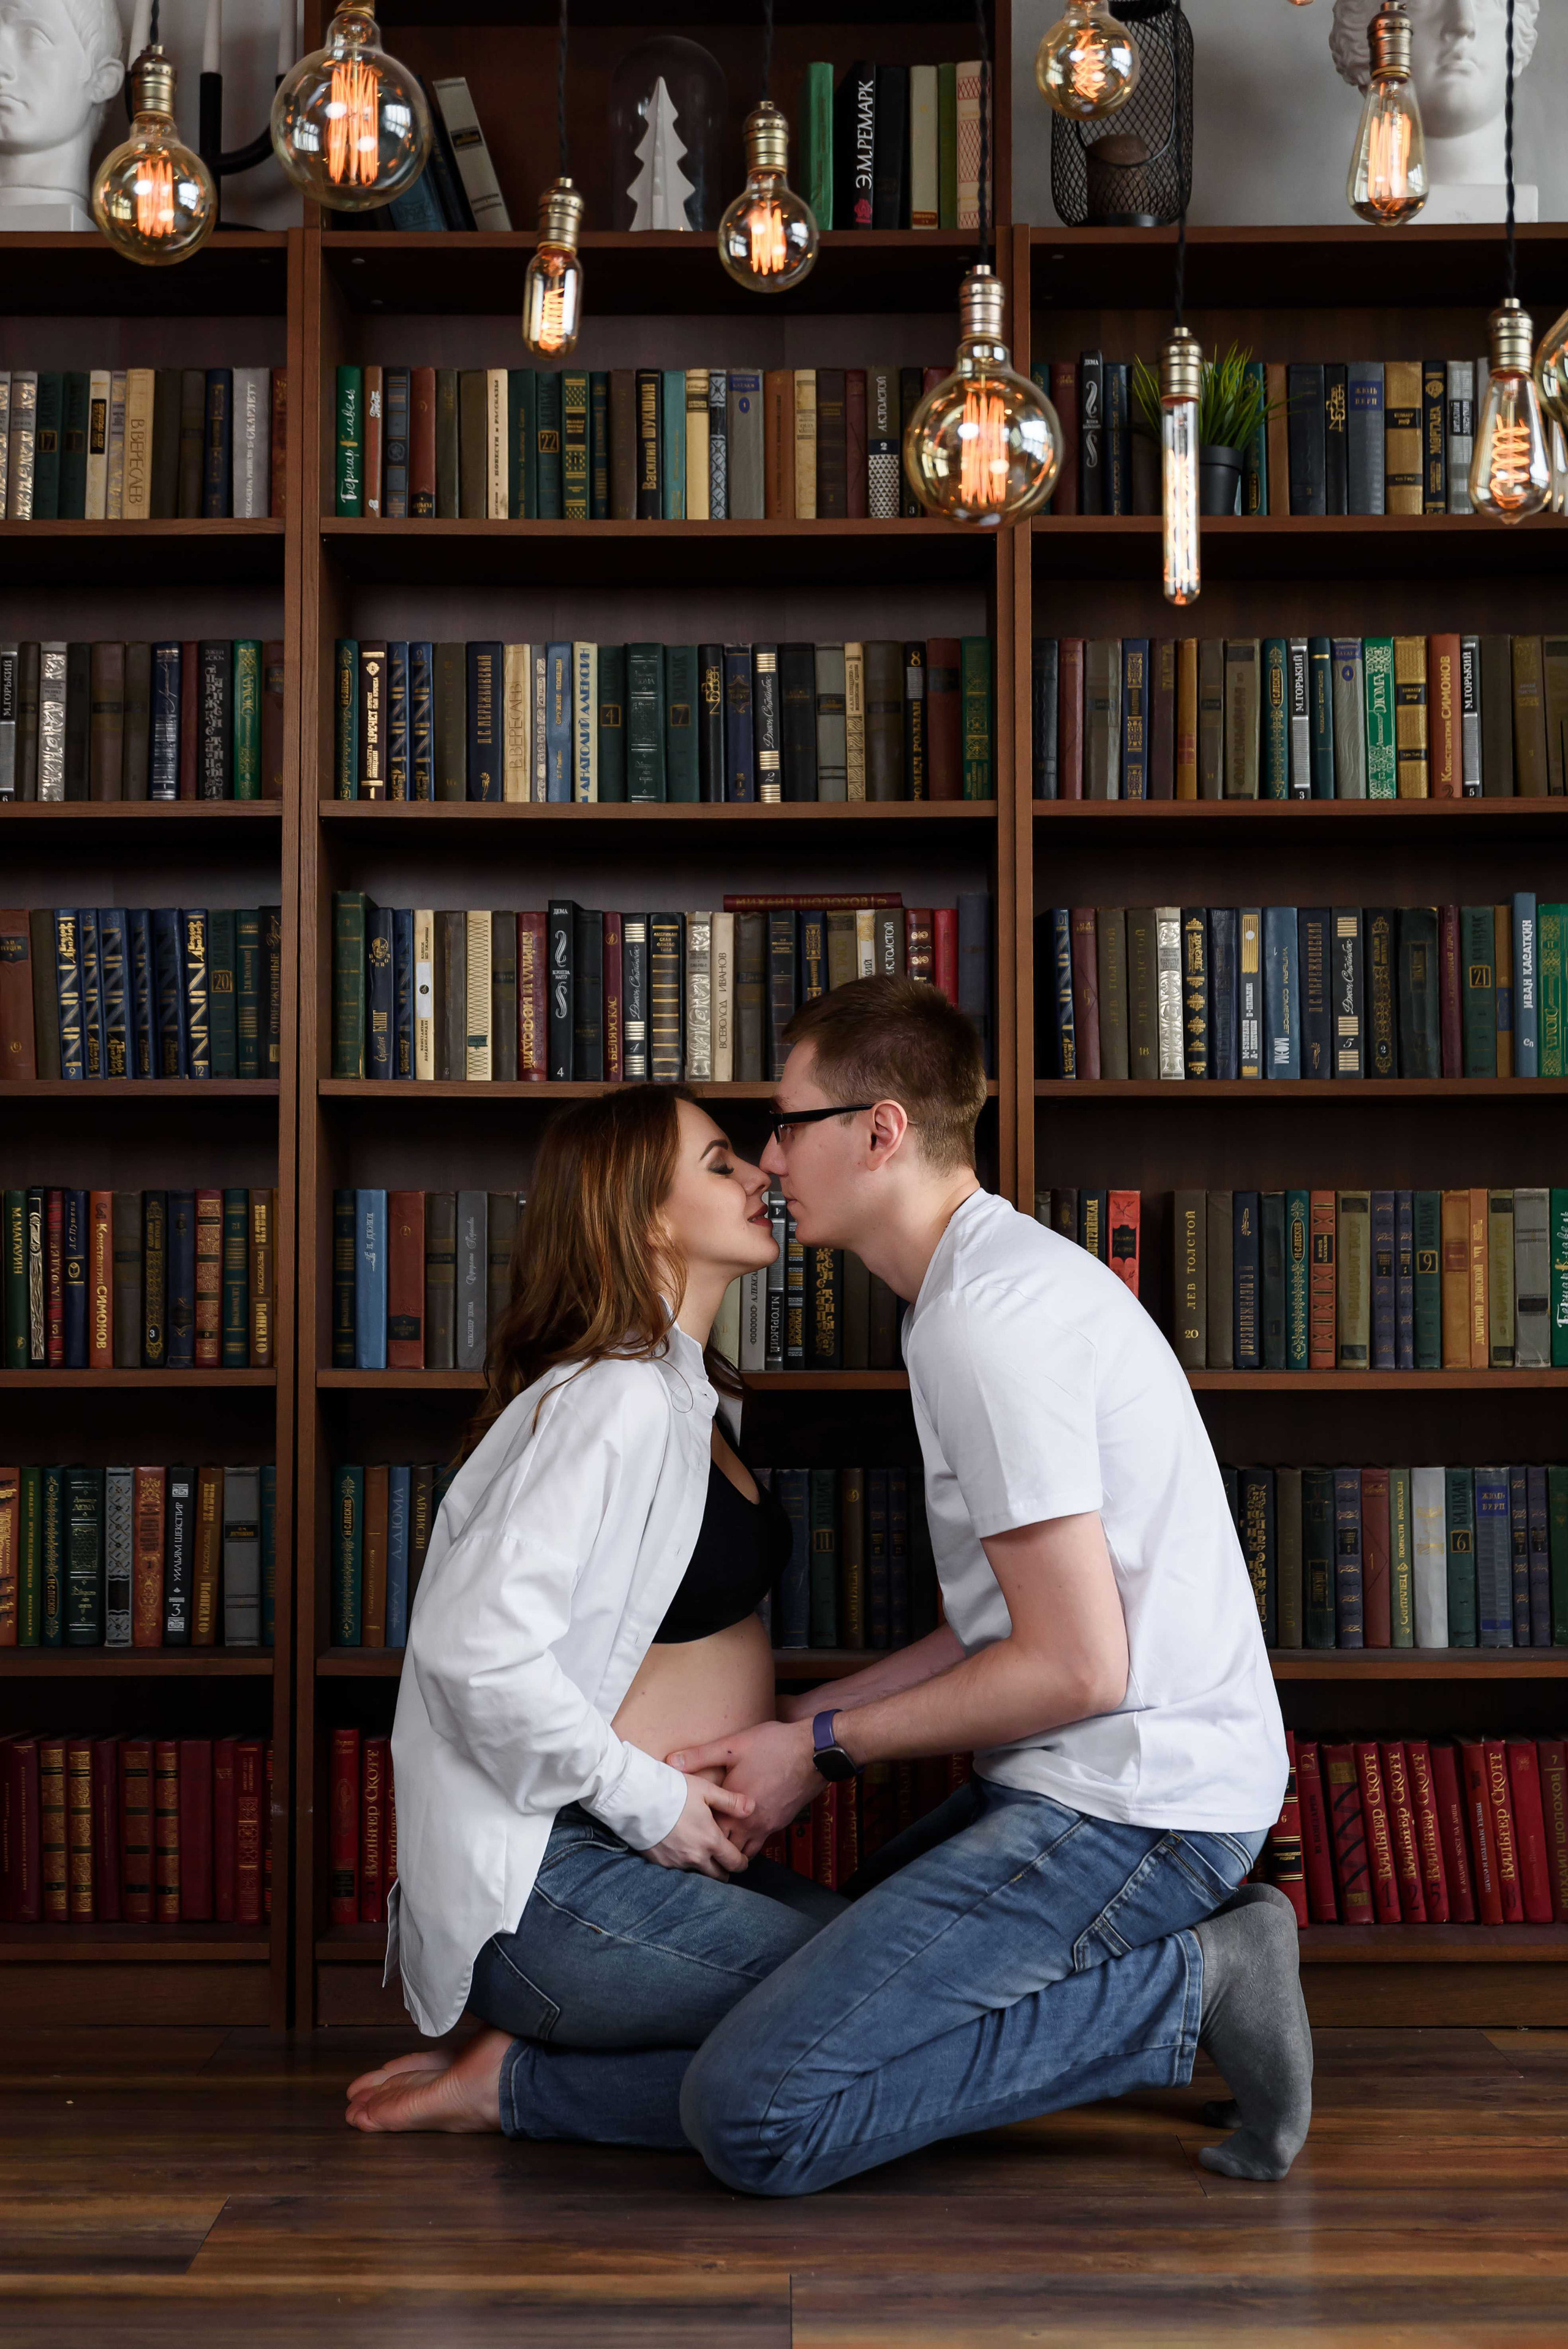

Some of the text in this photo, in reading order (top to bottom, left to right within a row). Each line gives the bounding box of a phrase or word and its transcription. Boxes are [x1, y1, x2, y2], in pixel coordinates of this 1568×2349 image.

[339, 388, 360, 502] Бернар Клавель
[541, 433, 556, 450] 22
[641, 383, 657, 490] Василий ШУКШИН
[880, 442, 888, 450] 2
[129, 431, 145, 503] ВЕРЕСАЕВ
[910, 505, 914, 515] 3
[910, 650, 921, 666] 8
[1293, 654, 1304, 712] М.ГОРЬКИЙ
[1462, 651, 1473, 709] М.ГОРЬКИЙ
[1, 660, 12, 716] М.ГОРЬКИЙ
[477, 655, 492, 727] МЕРЕЖКОВСКИЙ
[761, 674, 774, 749] Джон Стейнбек
[1373, 673, 1387, 714] ДЮМА
[367, 709, 379, 743] КРЕЧЕТ
[508, 683, 522, 768] В. ВЕРЕСАЕВ
[578, 648, 590, 792] АНАТОЛИЙ АЛЕКСИН
[606, 708, 614, 724] 4
[912, 701, 922, 752] РОЛЛАН
[1440, 655, 1452, 782] Константин СИМОНОВ
[369, 787, 375, 800] 1
[765, 771, 775, 782] 2
[1299, 790, 1305, 800] 3
[736, 896, 869, 907] МИХАИЛ ШОЛОХОВ
[521, 931, 535, 981] КИРИЛЛ
[1106, 928, 1120, 1026] ЛЕВ ТОЛСТОЙ
[1135, 928, 1148, 1024] ЛЕВ ТОЛСТОЙ
[1306, 921, 1322, 995] МЕРЕЖКОВСКИЙ
[1341, 937, 1354, 1015] Джон Стейнбек
[1474, 967, 1486, 986] 21
[1522, 919, 1534, 1009] ИВАН КАСАТКИН
[215, 974, 228, 989] 20
[270, 952, 280, 1034] ОТВЕРЖЕННЫЕ
[628, 944, 640, 1019] Джон Стейнбек
[718, 953, 727, 1049] ВСЕВОЛОД ИВАНОВ
[372, 1010, 388, 1032] КИНГ
[521, 996, 537, 1069] МЕФОДИЙ
[608, 996, 618, 1073] А. БЕЛЯУСКАС
[1342, 1037, 1354, 1048] 5
[69, 1067, 76, 1076] 9
[195, 1065, 205, 1076] 12
[557, 1067, 564, 1077] 4
[1273, 1037, 1290, 1064] МОЭМ
[1380, 1045, 1386, 1053] 2
[12, 1207, 23, 1274] М. МАГАУИН
[50, 1233, 61, 1297] А. ФАДЕЕВ
[1185, 1210, 1196, 1310] ЛЕВ ТОЛСТОЙ
[1423, 1254, 1433, 1271] 9
[96, 1223, 108, 1349] Константин СИМОНОВ
[257, 1250, 265, 1294] РАССКАЗЫ
[770, 1295, 781, 1353] М.ГОРЬКИЙ
[1240, 1282, 1257, 1356] МЕРЕЖКОВСКИЙ
[1472, 1264, 1485, 1345] ДМИТРИЙ ДОНСКОЙ
[149, 1330, 156, 1338] 3
[1185, 1329, 1199, 1338] 20
[174, 1502, 183, 1543] ШЕКСПИР
[415, 1482, 427, 1549] А. АЙЛИСЛИ
[1452, 1480, 1468, 1524] БАЛЬЗАК
[202, 1529, 211, 1574] РАССКАЗЫ
[1368, 1552, 1374, 1570] 1
[1457, 1533, 1466, 1551] 6
[172, 1603, 181, 1617] 3
[1551, 1754, 1558, 1765] 7
[1281, 1815, 1287, 1823] 6
[1363, 1753, 1392, 1880] ВАЛЬТЕР СКОТТ
[1388, 1752, 1417, 1880] ВАЛЬТЕР СКОТТ
[1412, 1753, 1441, 1881] ВАЛЬТЕР СКОТТ
[1489, 1752, 1516, 1881] ВАЛЬТЕР СКОТТ
[1550, 1772, 1568, 1908] МИХАИЛ ШОЛОХОВ
[1381, 1881, 1393, 1908] 1
[1408, 1884, 1419, 1910] 2
[1431, 1883, 1441, 1908] 5
